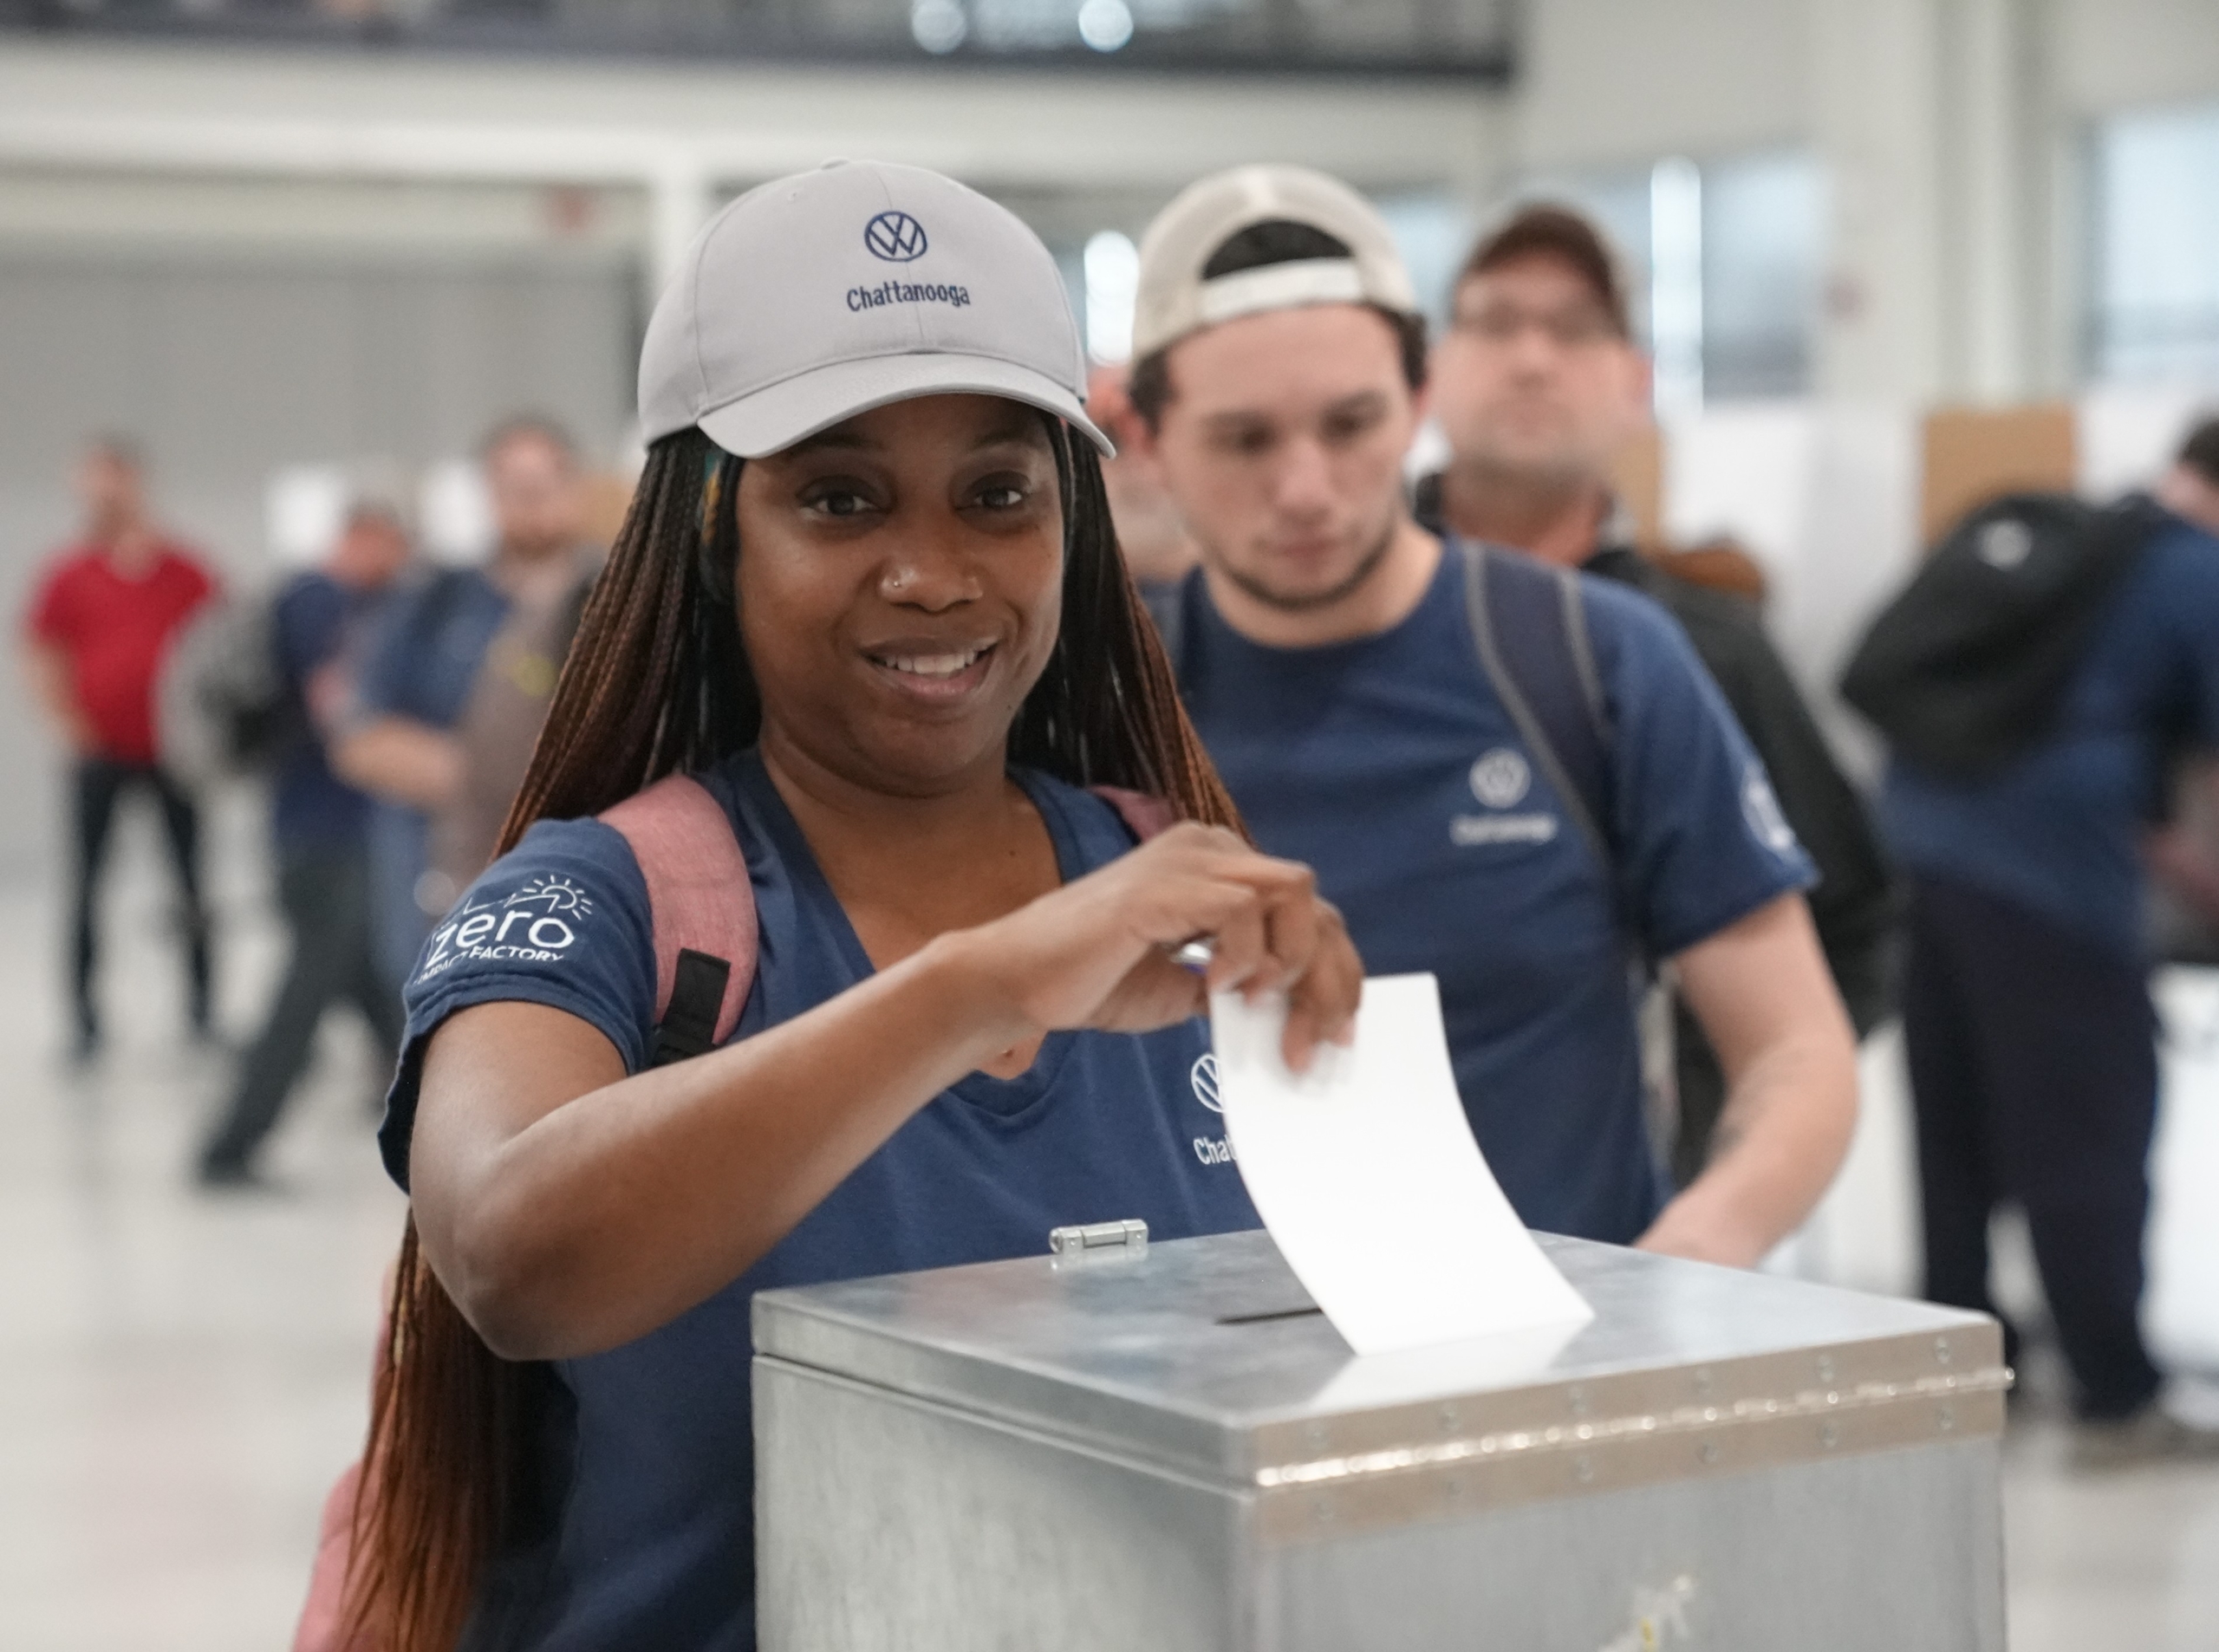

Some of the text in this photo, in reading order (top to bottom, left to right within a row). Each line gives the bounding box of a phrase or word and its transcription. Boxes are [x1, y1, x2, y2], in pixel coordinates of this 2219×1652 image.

[865, 212, 925, 260] VW
[846, 280, 971, 312] Chattanooga
[425, 910, 575, 969] zero
[468, 946, 564, 962] FACTORY
